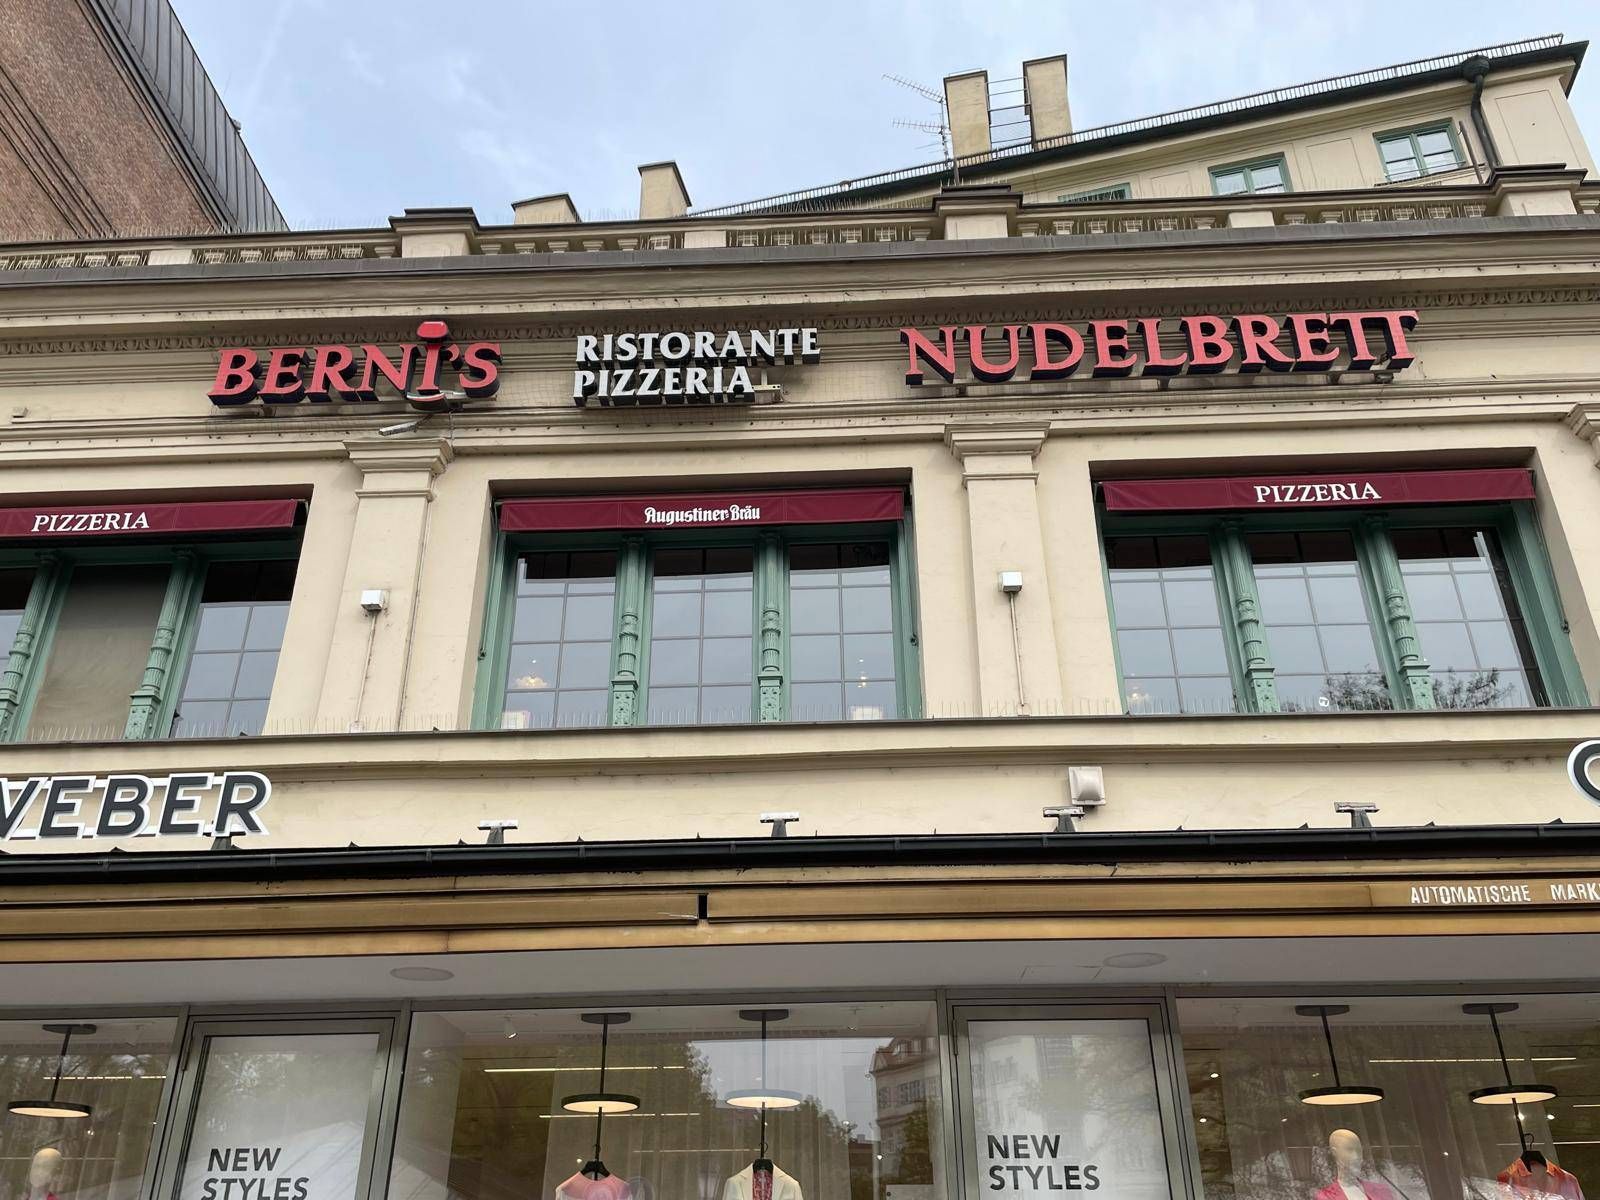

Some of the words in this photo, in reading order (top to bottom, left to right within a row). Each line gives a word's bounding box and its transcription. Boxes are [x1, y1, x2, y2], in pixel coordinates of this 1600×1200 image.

[576, 328, 821, 367] RISTORANTE
[900, 310, 1420, 384] NUDELBRETT
[573, 366, 755, 406] PIZZERIA
[1253, 482, 1382, 503] PIZZERIA
[31, 511, 150, 532] PIZZERIA
[1411, 884, 1531, 904] AUTOMATISCHE
[1550, 882, 1600, 901] MARK
[987, 1135, 1061, 1159] NEW
[207, 1148, 282, 1172] NEW
[200, 1177, 309, 1200] STYLES
[989, 1165, 1101, 1190] STYLES
